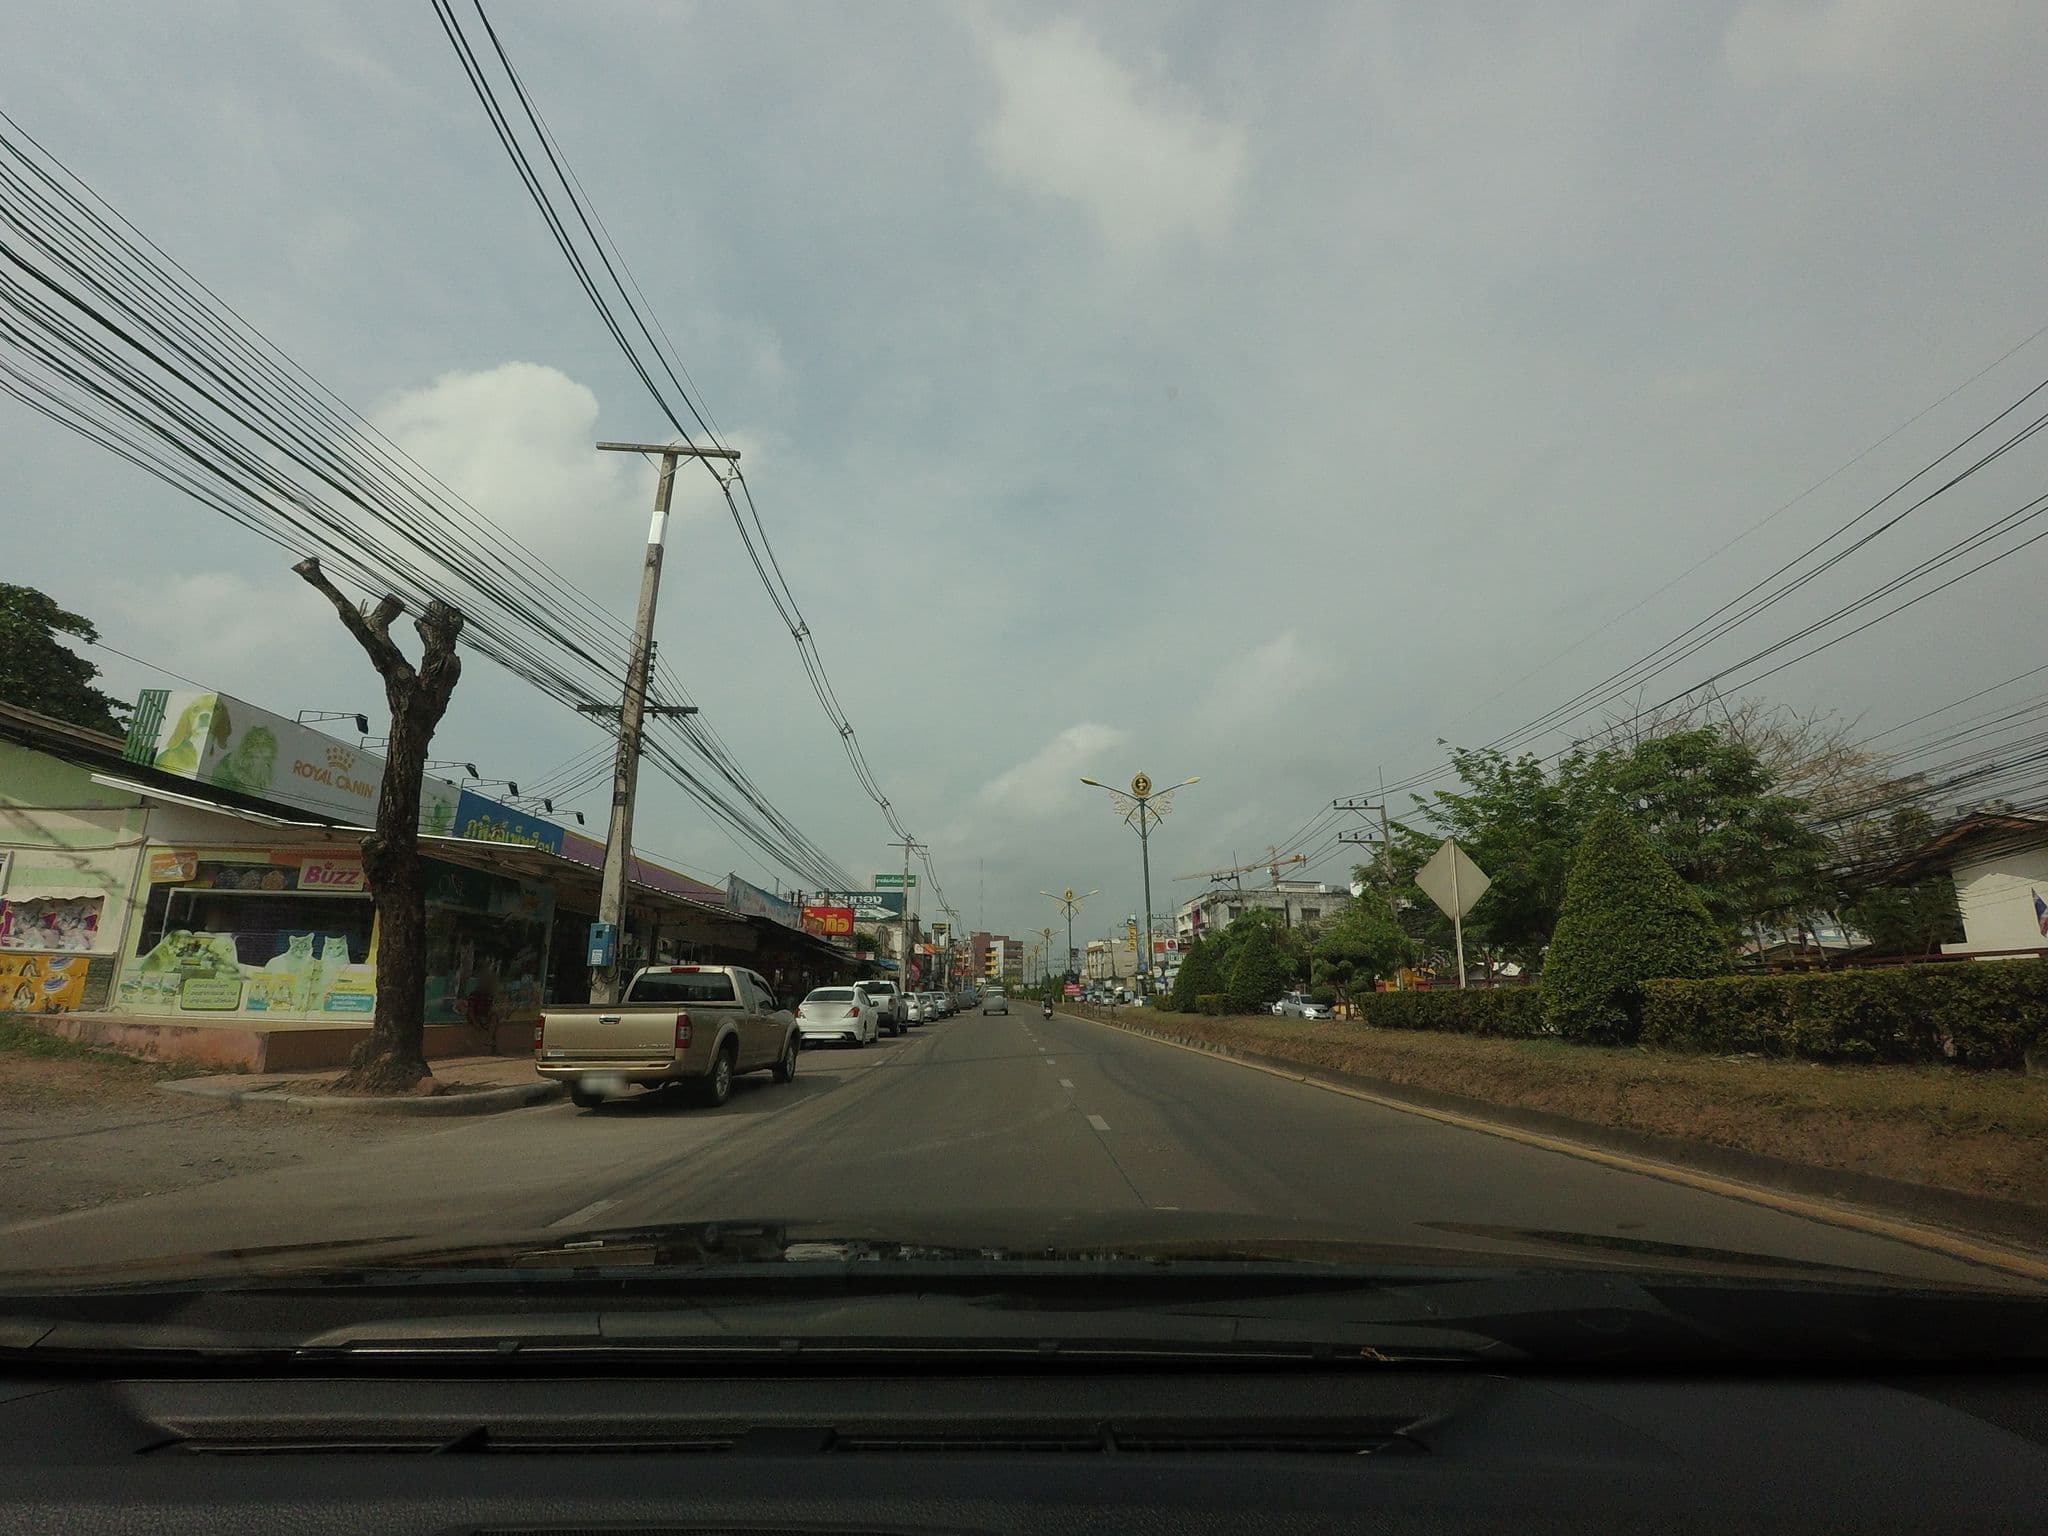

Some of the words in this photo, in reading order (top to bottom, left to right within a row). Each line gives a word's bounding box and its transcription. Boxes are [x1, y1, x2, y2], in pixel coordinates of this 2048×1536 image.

[292, 759, 333, 787] ROYAL
[336, 775, 375, 799] CANIN
[303, 865, 360, 884] BUZZ
